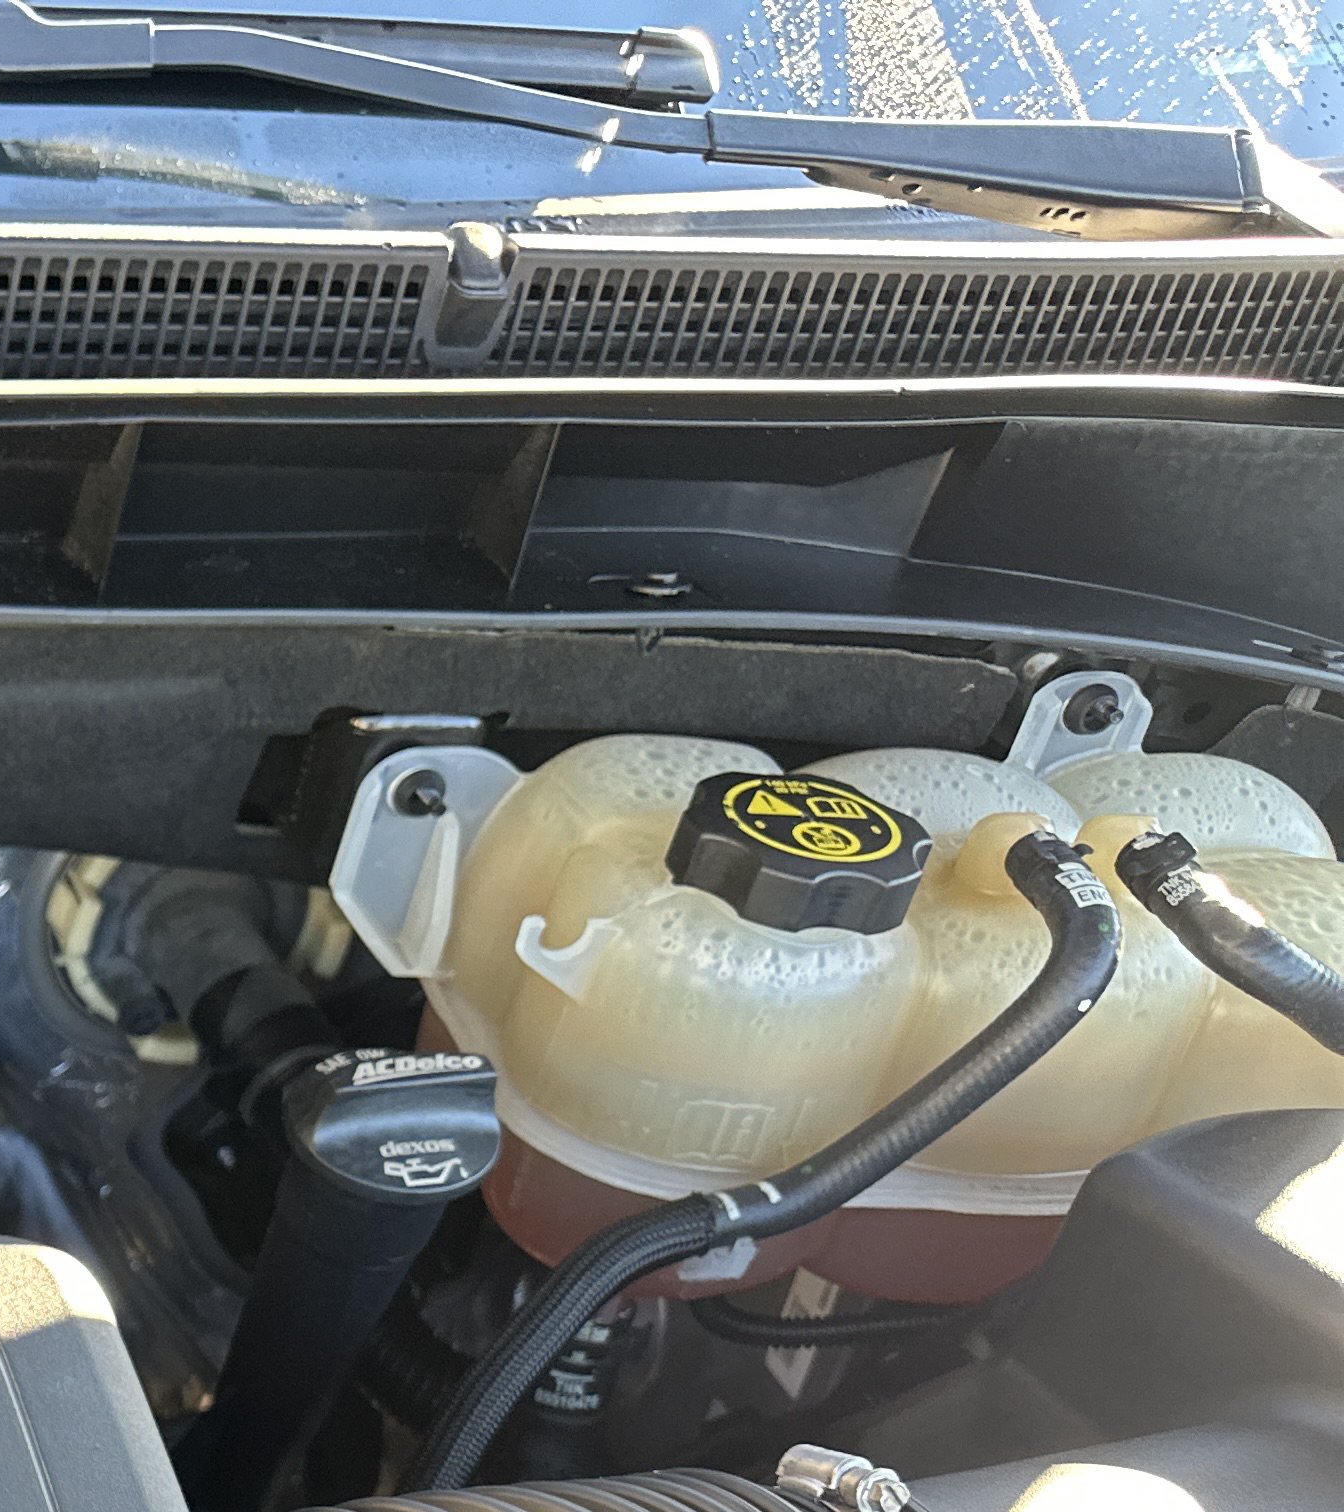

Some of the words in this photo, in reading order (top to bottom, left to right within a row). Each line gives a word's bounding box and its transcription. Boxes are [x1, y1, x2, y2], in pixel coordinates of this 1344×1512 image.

[315, 1052, 352, 1075] SAE
[352, 1053, 483, 1083] ACDelco
[379, 1138, 455, 1158] dexos
